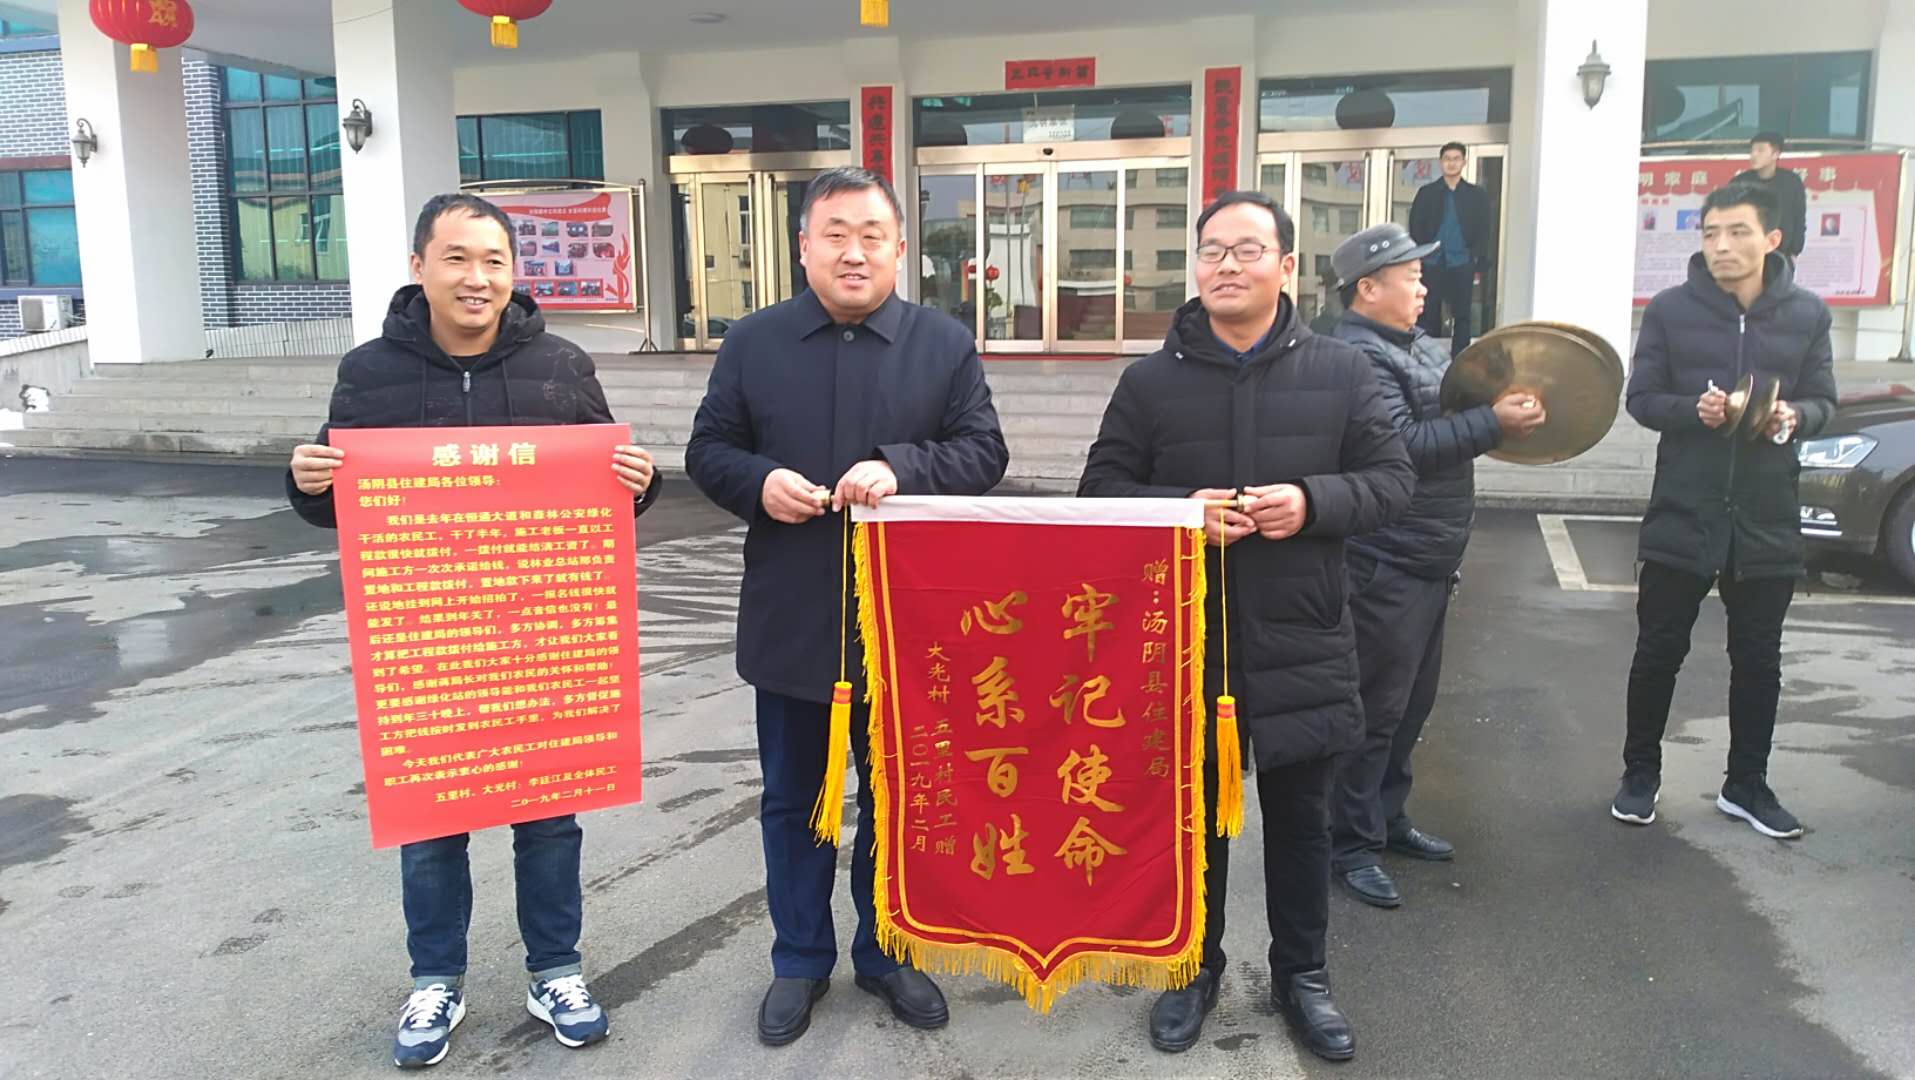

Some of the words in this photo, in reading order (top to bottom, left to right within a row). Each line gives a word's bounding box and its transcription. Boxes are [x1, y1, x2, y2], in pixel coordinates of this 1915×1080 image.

[432, 442, 536, 465] 感谢信
[931, 718, 957, 855] 五里村民工赠
[960, 590, 1035, 880] 心系百姓
[1049, 583, 1127, 886] 牢记使命
